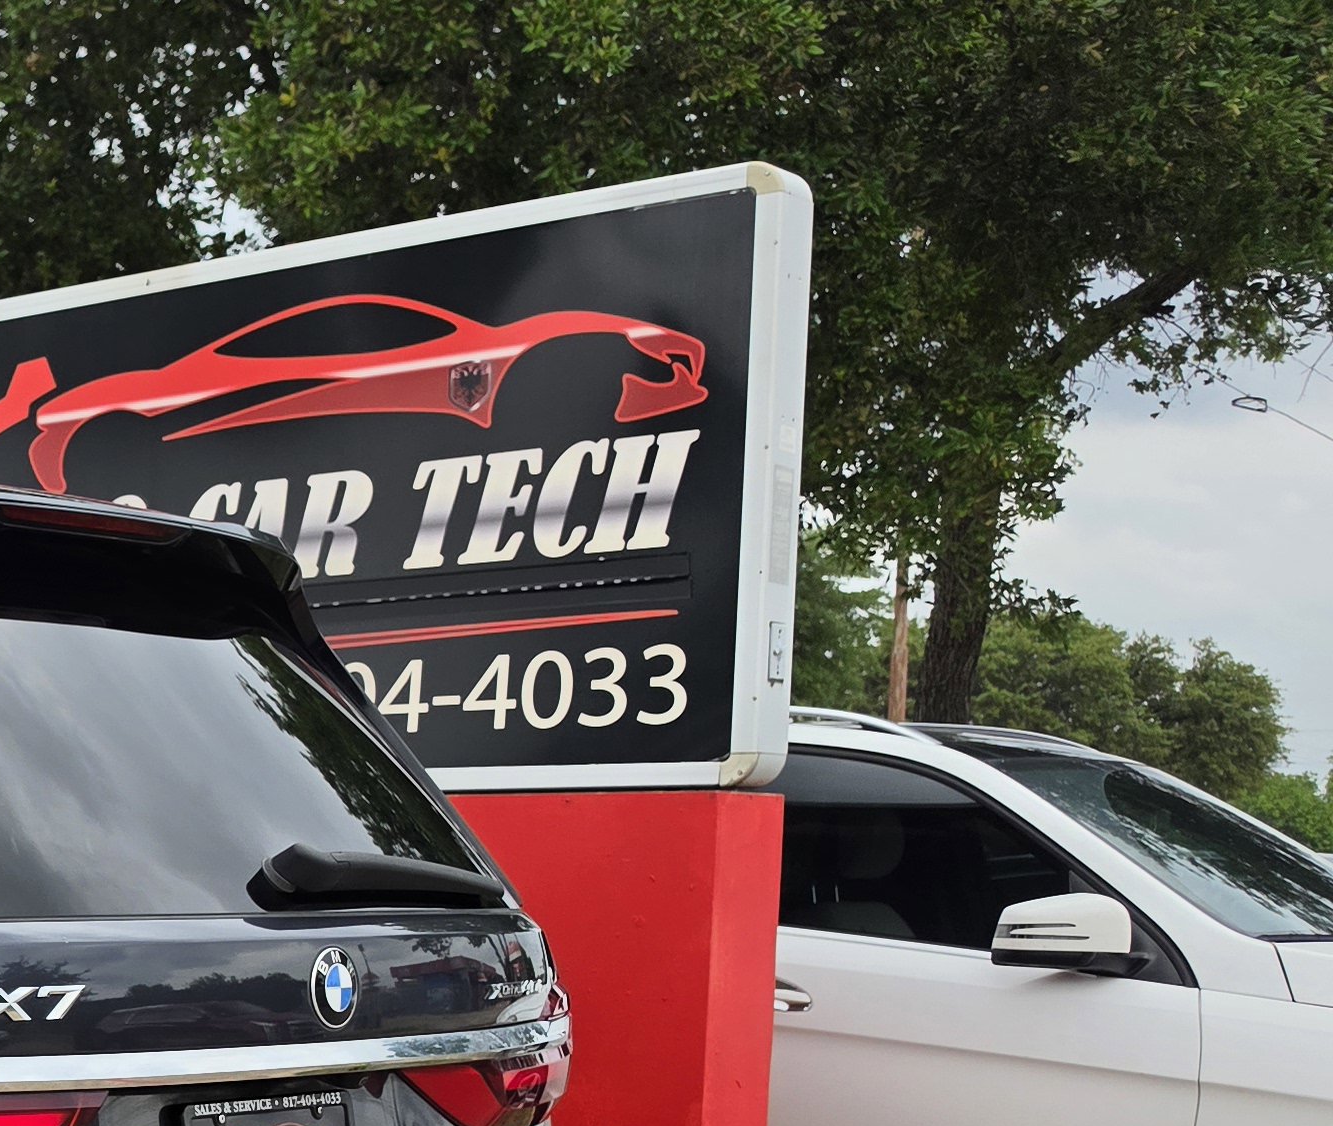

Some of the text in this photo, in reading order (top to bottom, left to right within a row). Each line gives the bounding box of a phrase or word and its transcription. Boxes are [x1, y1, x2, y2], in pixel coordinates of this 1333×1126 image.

[403, 429, 701, 570] TECH
[194, 1092, 342, 1117] SALES & SERVICE 817-404-4033
